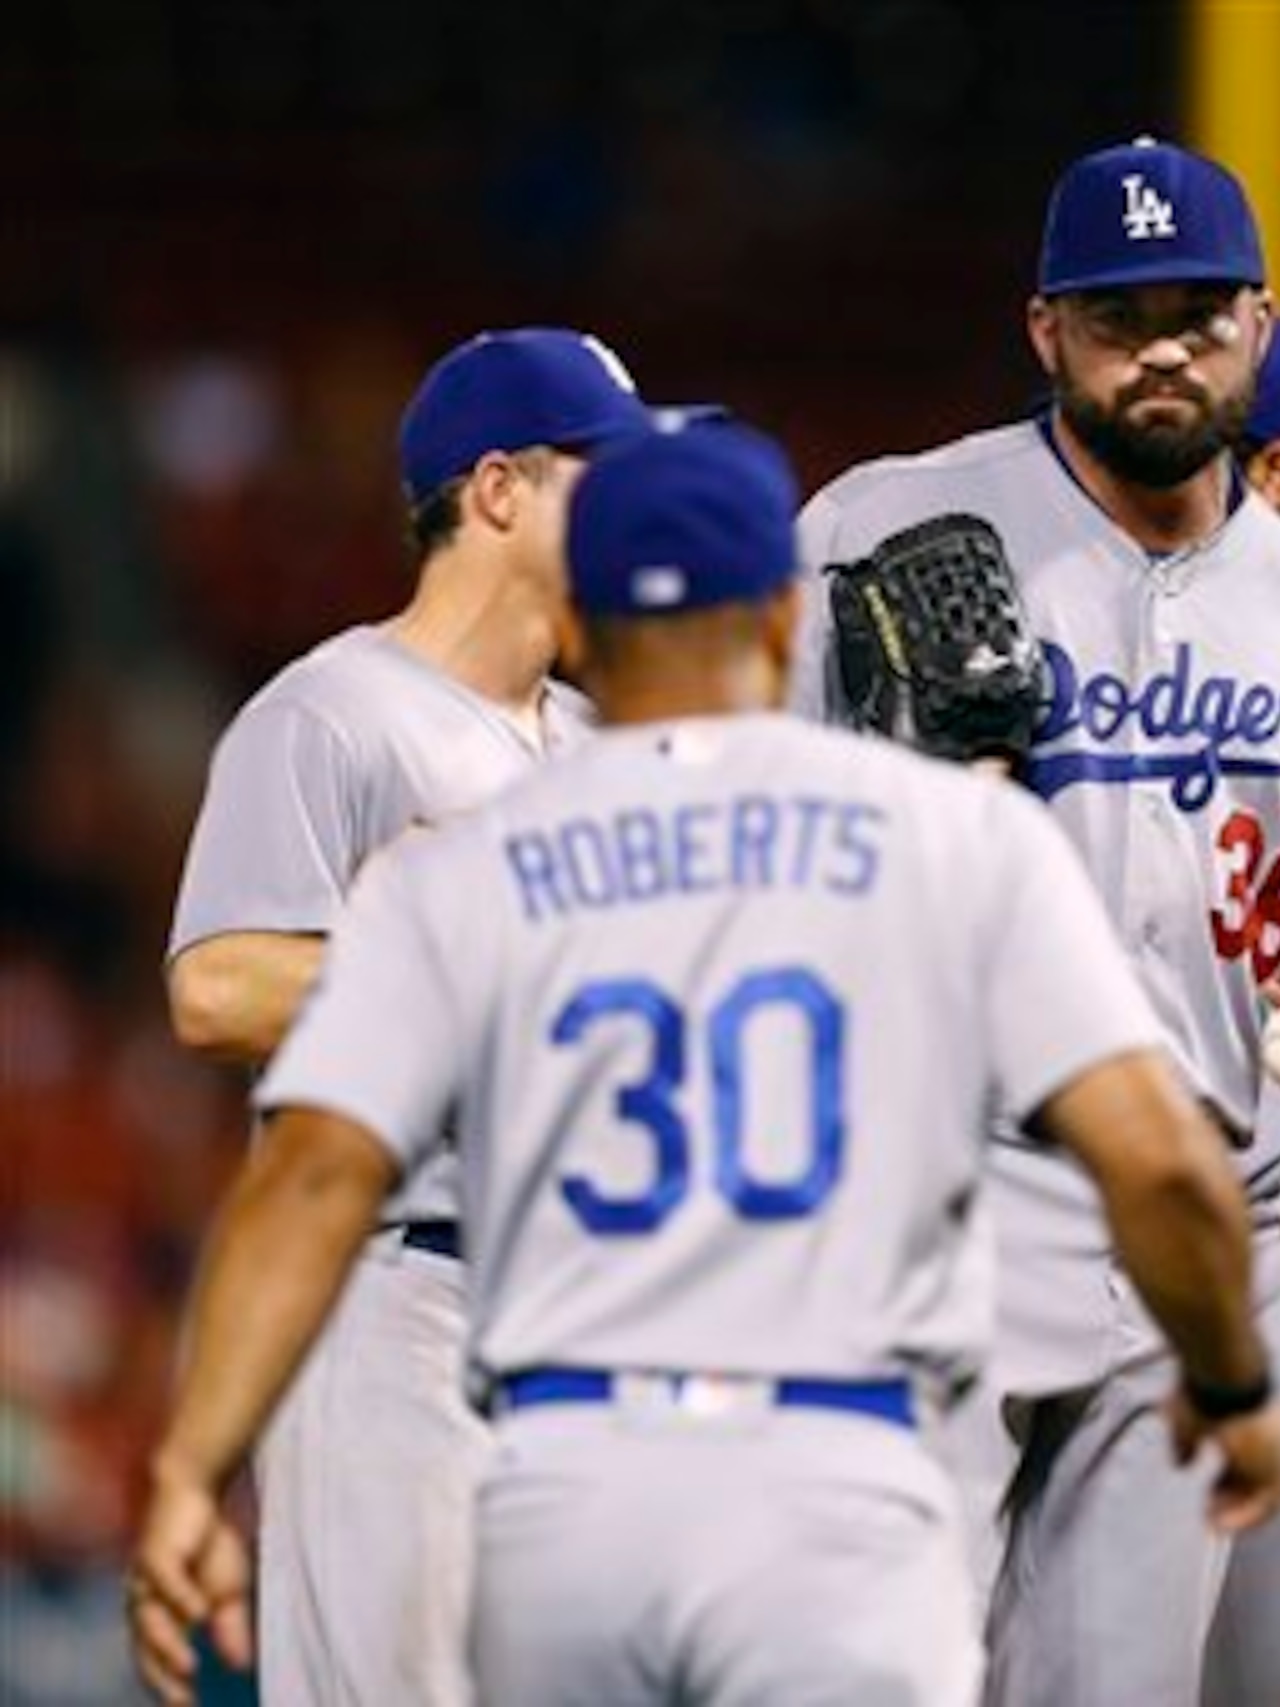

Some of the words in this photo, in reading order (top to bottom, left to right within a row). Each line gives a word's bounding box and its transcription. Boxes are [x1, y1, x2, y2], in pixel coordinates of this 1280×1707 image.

[1121, 173, 1177, 239] LA
[505, 795, 888, 920] ROBERTS
[550, 965, 847, 1237] 30
